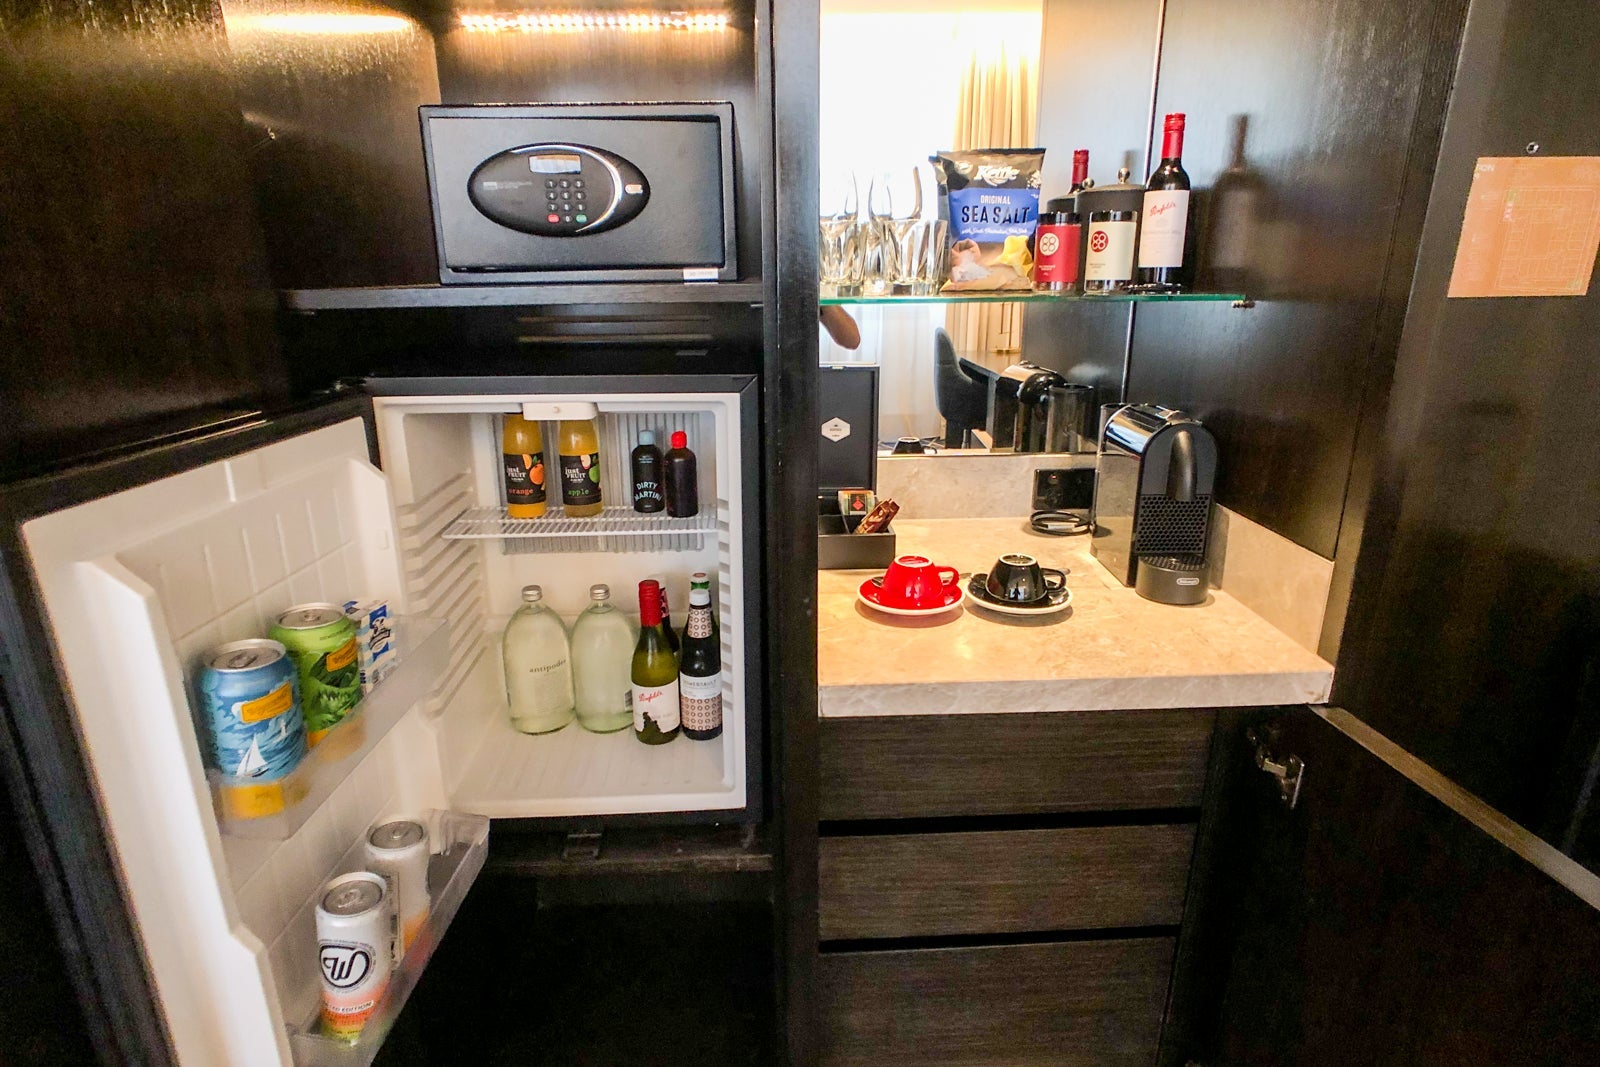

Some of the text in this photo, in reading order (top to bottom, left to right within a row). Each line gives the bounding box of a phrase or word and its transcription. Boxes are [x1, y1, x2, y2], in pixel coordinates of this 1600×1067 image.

[980, 194, 1011, 205] ORIGINAL
[961, 205, 1030, 224] SEA SALT
[564, 466, 579, 475] just
[636, 481, 658, 490] DIRTY
